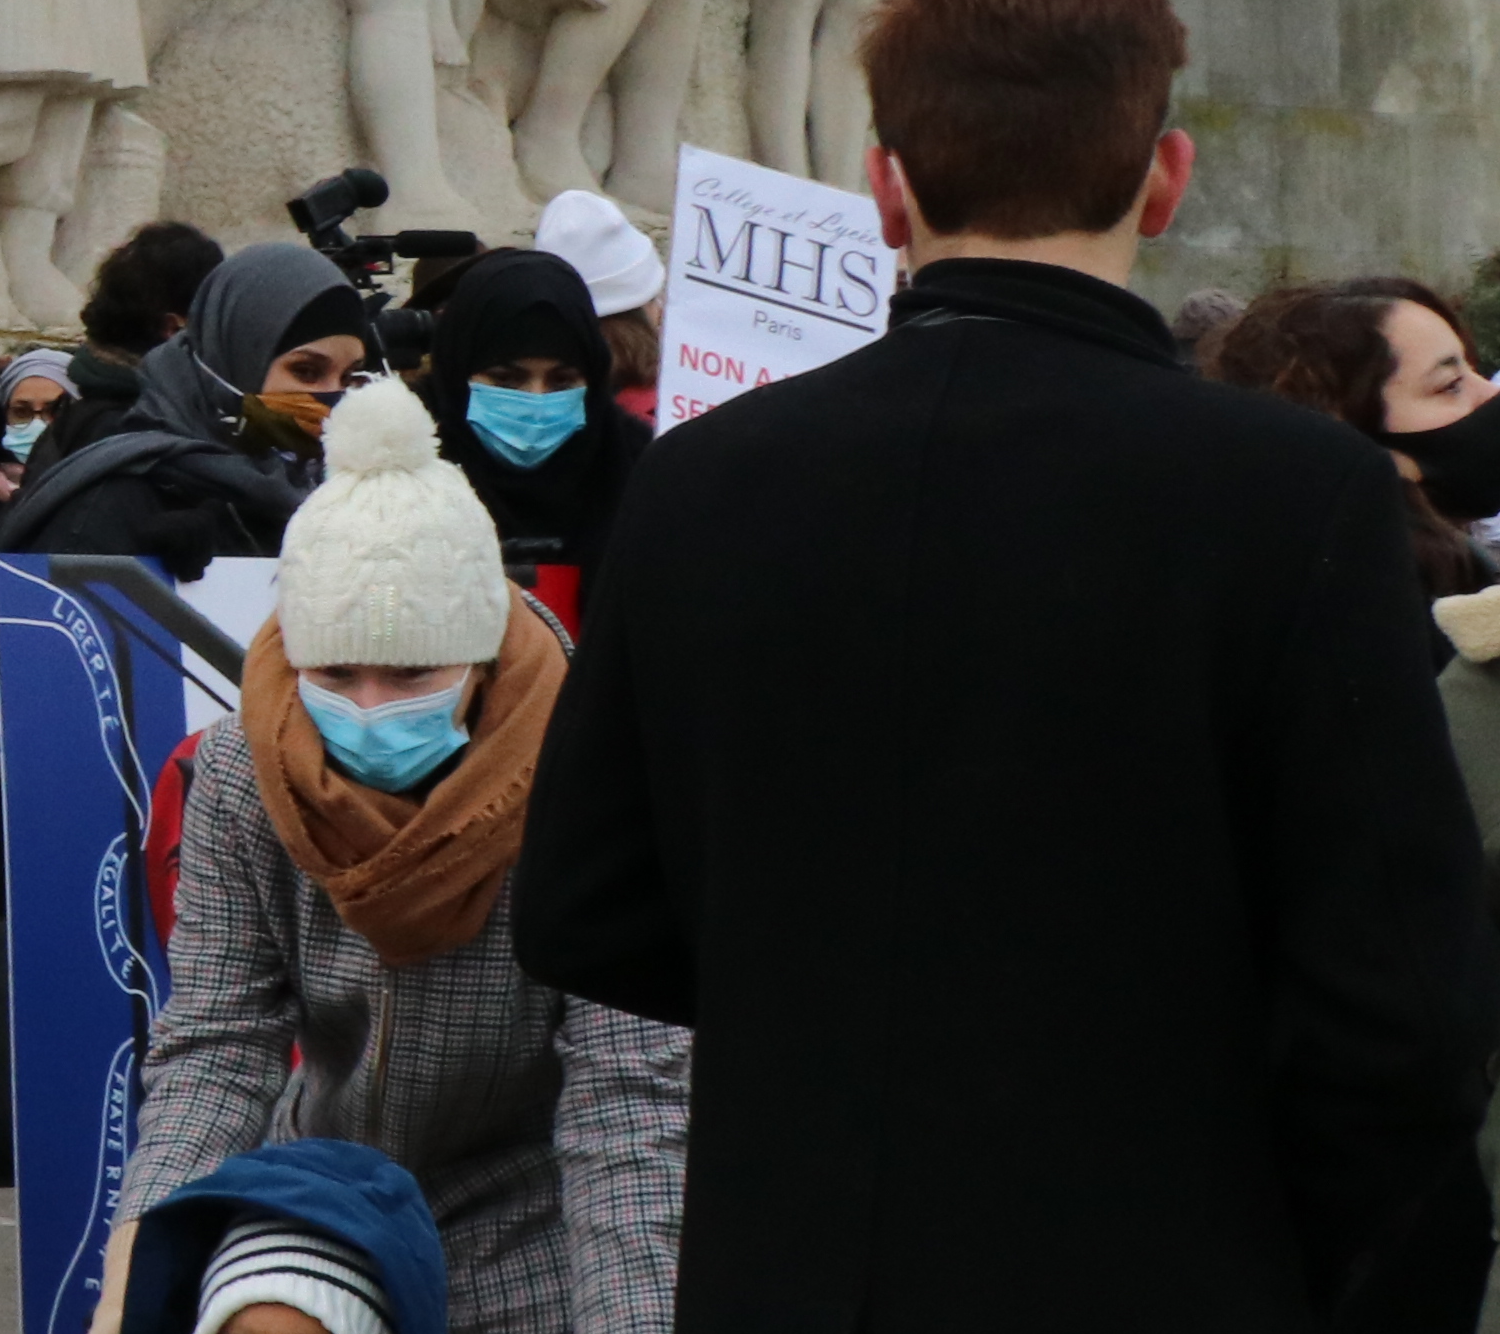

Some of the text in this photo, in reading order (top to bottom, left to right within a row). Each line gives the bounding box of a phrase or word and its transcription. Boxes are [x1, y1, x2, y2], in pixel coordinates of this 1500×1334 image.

[686, 204, 879, 318] MHS
[753, 310, 802, 341] Paris
[680, 343, 745, 385] NON
